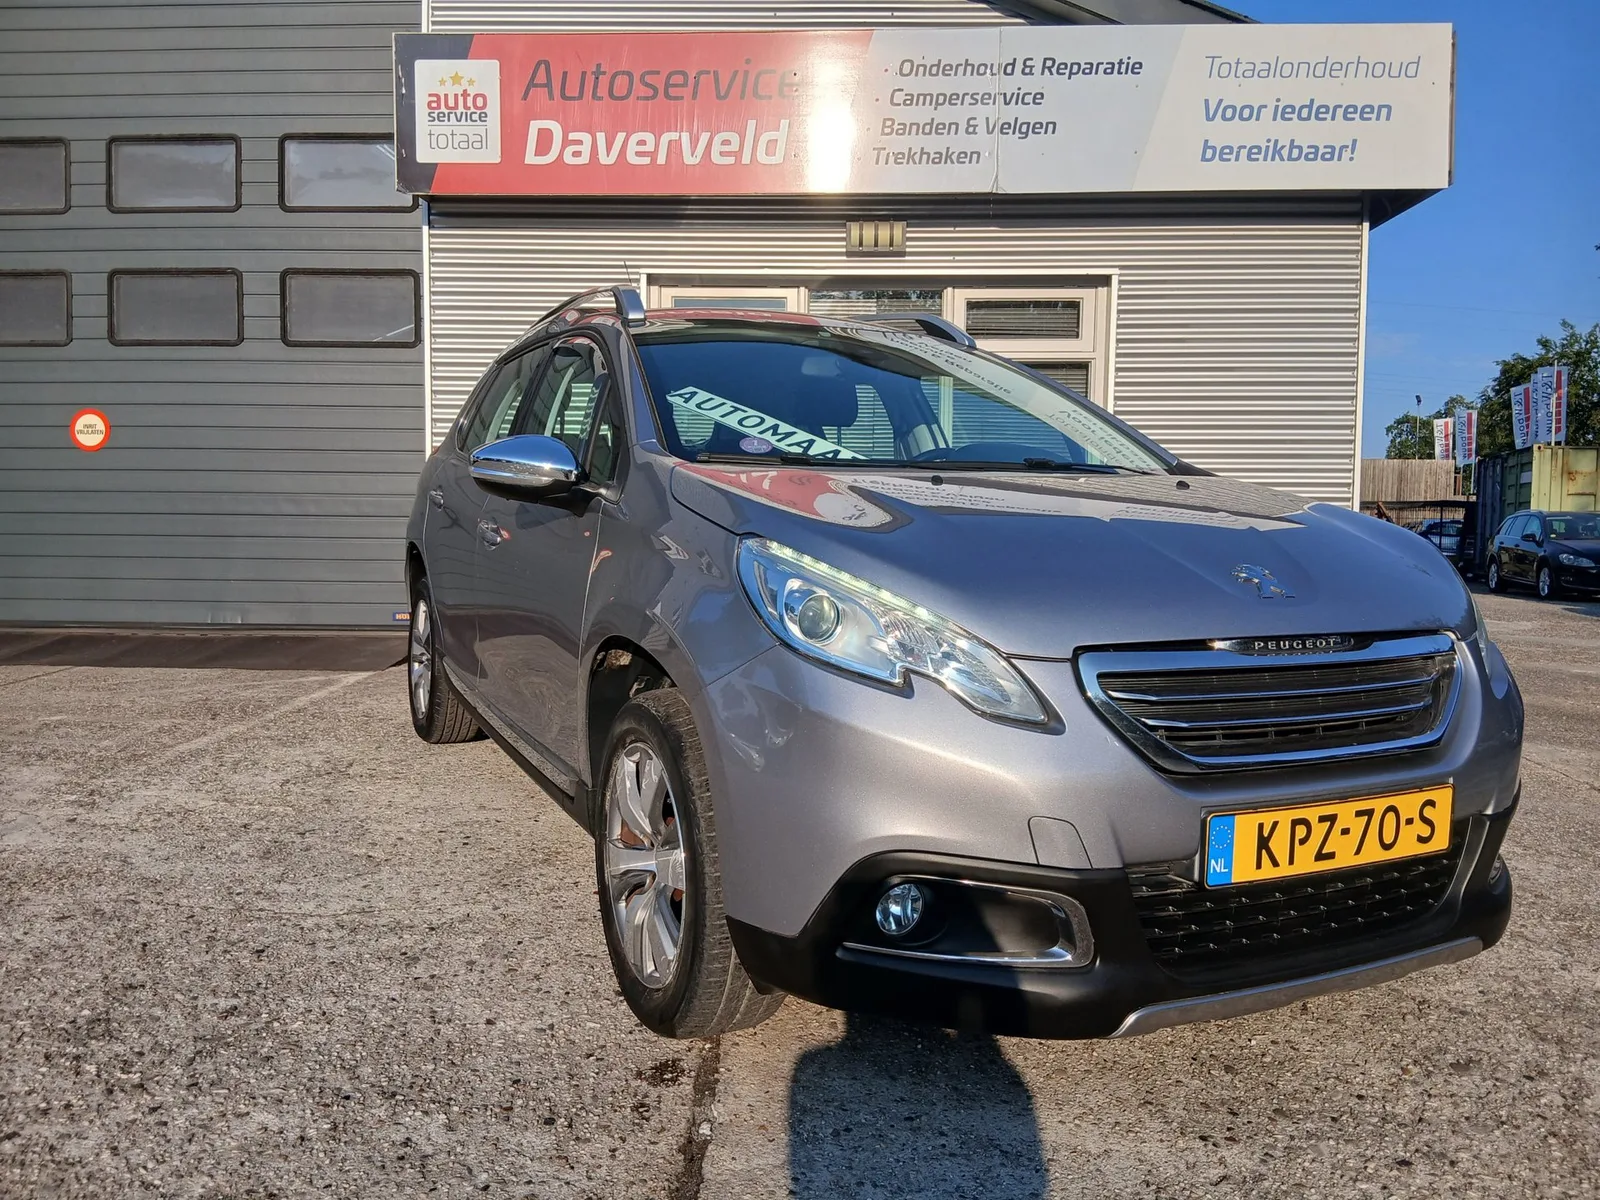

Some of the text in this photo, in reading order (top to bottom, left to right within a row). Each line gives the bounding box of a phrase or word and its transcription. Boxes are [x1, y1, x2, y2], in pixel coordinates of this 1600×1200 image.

[898, 56, 1143, 80] Onderhoud & Reparatie
[1204, 55, 1421, 79] Totaalonderhoud
[521, 58, 802, 102] Autoservice
[426, 89, 488, 111] auto
[888, 86, 1045, 111] Camperservice
[1203, 97, 1392, 122] Voor iedereen
[427, 110, 488, 123] service
[879, 116, 1058, 140] Banden & Velgen
[428, 127, 489, 151] totaal
[523, 119, 790, 166] Daverveld
[1200, 138, 1358, 163] bereikbaar!
[871, 145, 981, 166] Trekhaken
[667, 390, 862, 461] AUTOMAA
[1253, 637, 1337, 651] PEUGEOT
[1254, 797, 1437, 871] KPZ-70-S
[1209, 857, 1229, 874] NL
